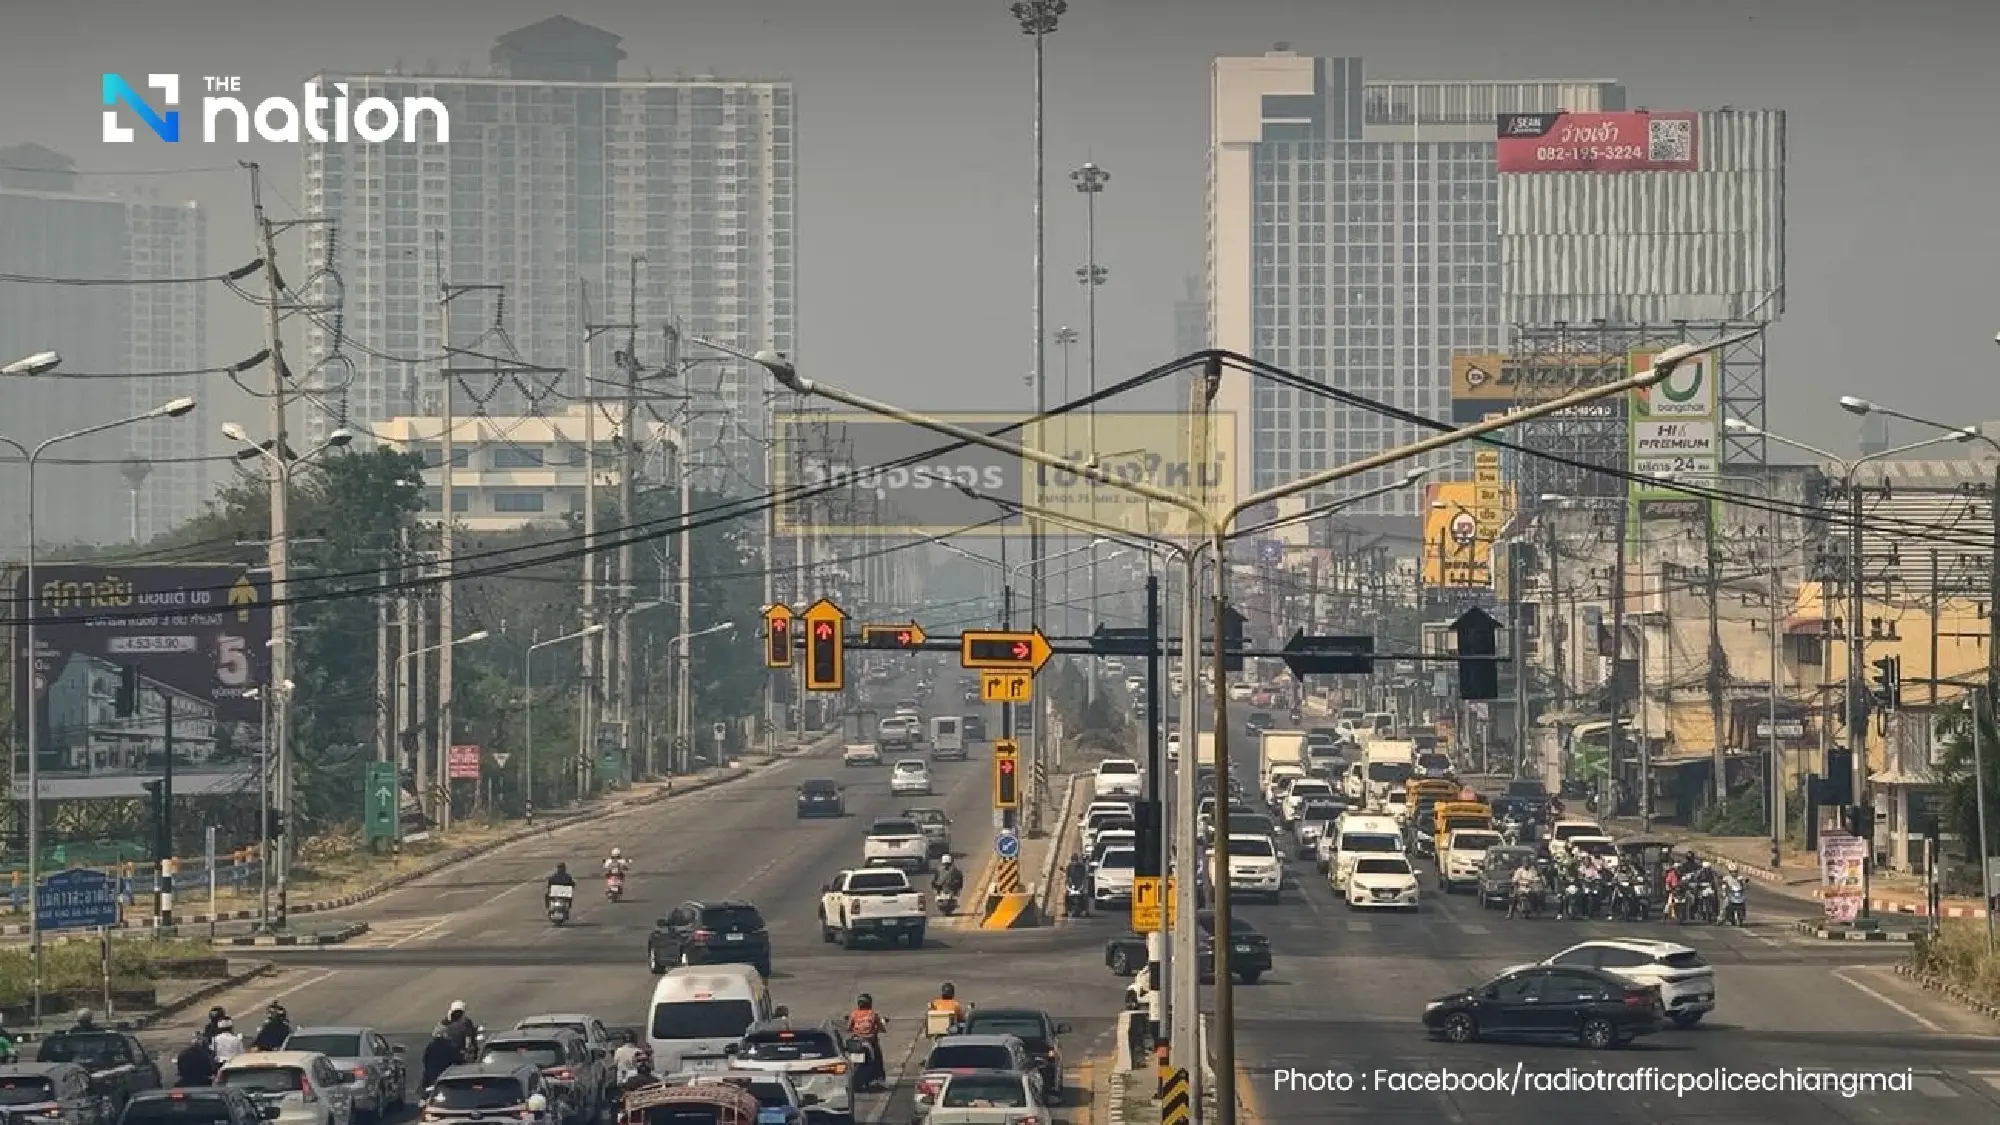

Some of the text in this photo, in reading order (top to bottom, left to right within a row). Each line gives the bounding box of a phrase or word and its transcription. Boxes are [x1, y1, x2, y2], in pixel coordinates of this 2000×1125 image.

[1537, 146, 1643, 160] 082-195-3224
[1639, 439, 1709, 448] PREMIUM
[1673, 457, 1695, 471] 24
[42, 576, 133, 616] ศุภาลัย
[217, 635, 248, 685] 5
